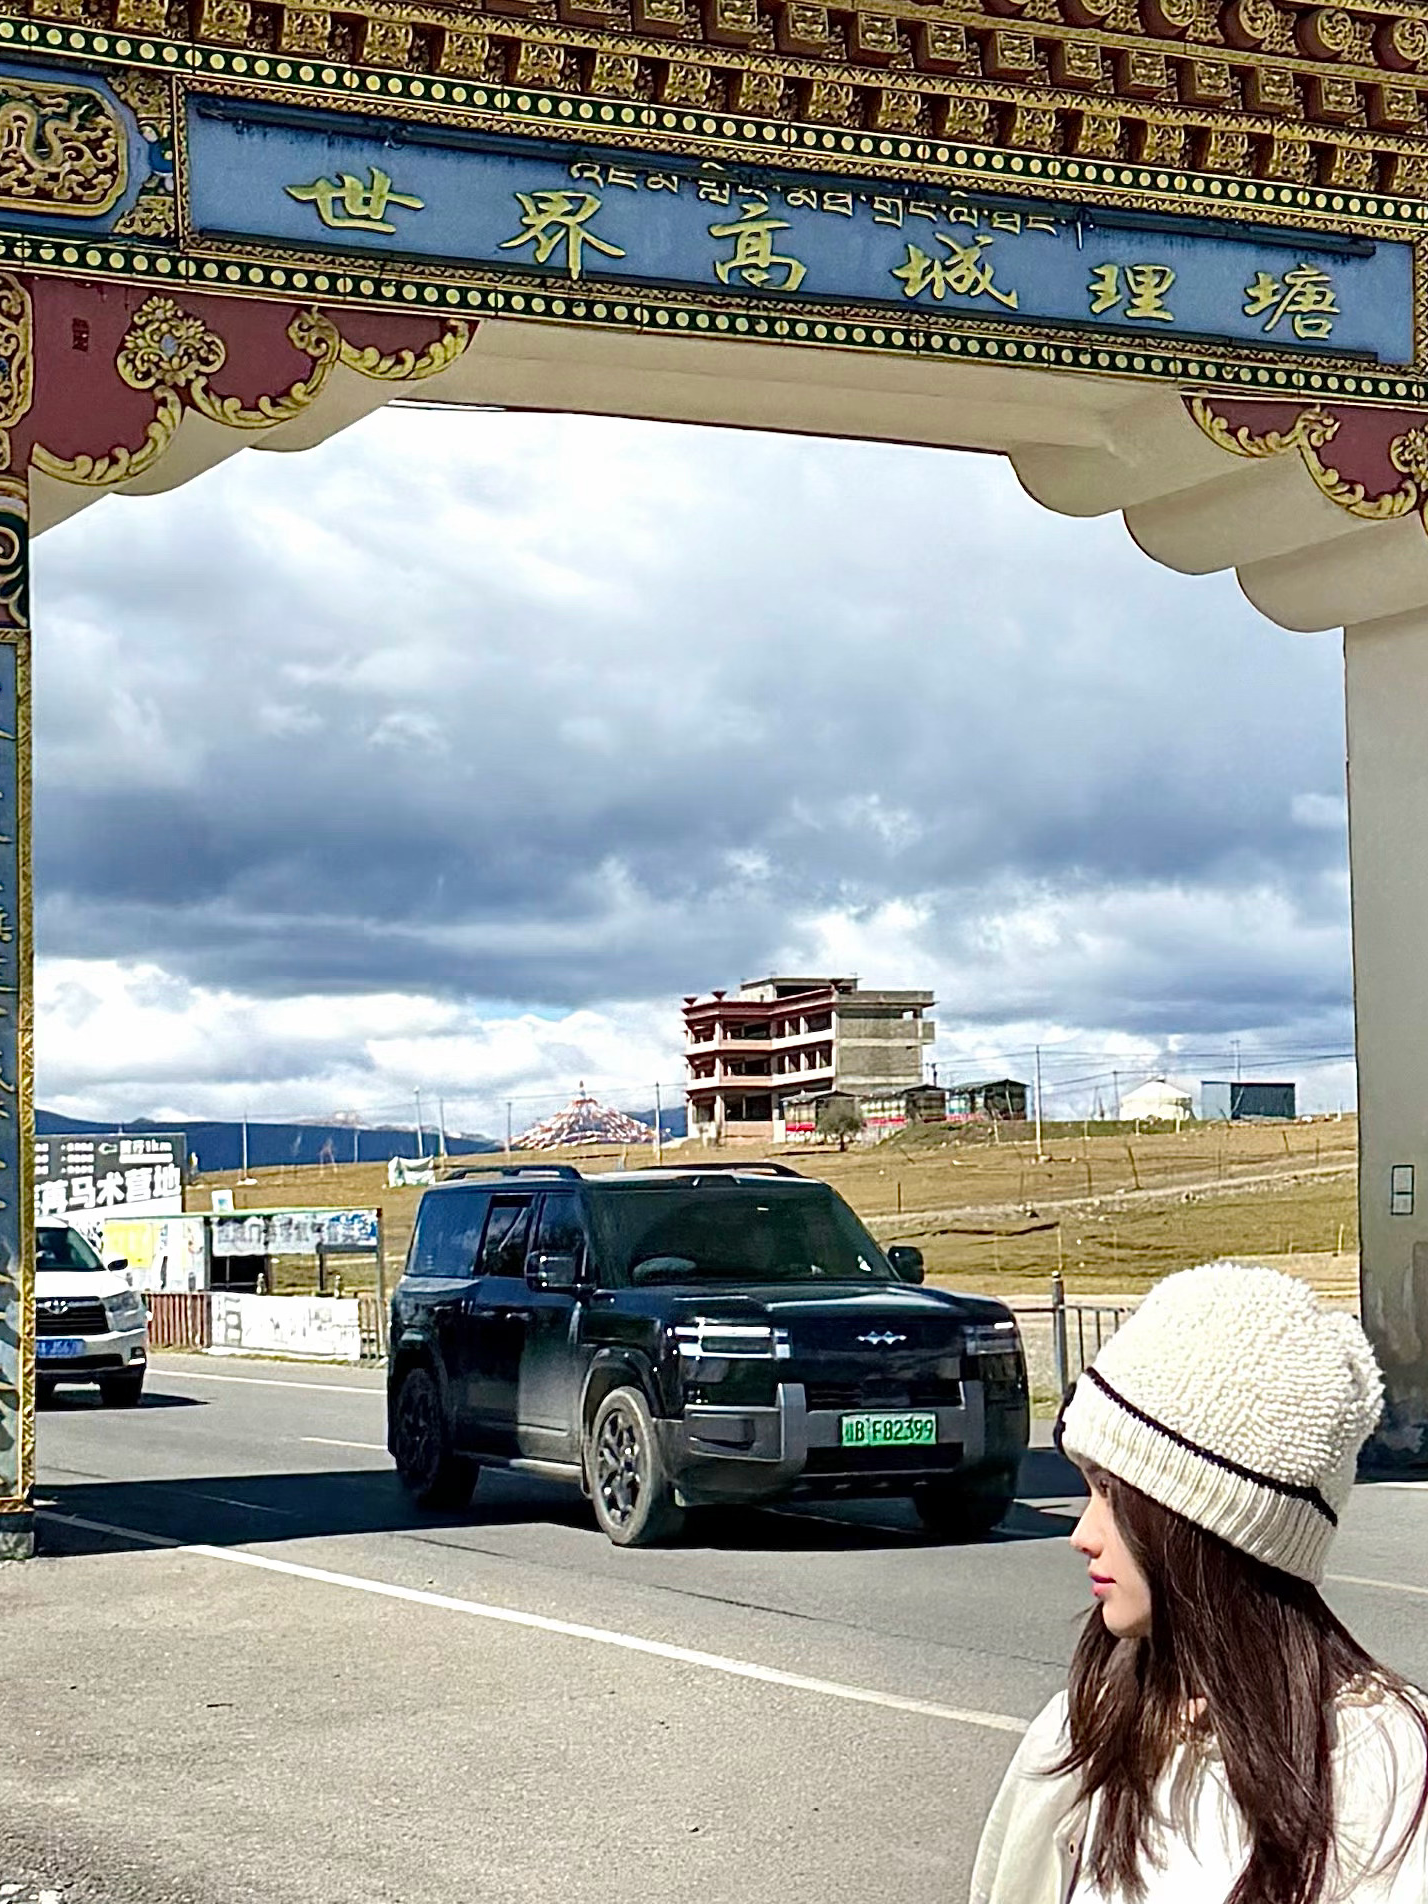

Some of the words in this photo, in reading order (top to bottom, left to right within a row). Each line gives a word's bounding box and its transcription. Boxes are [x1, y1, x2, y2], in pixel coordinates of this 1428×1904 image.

[284, 165, 1341, 340] 世界高城理塘
